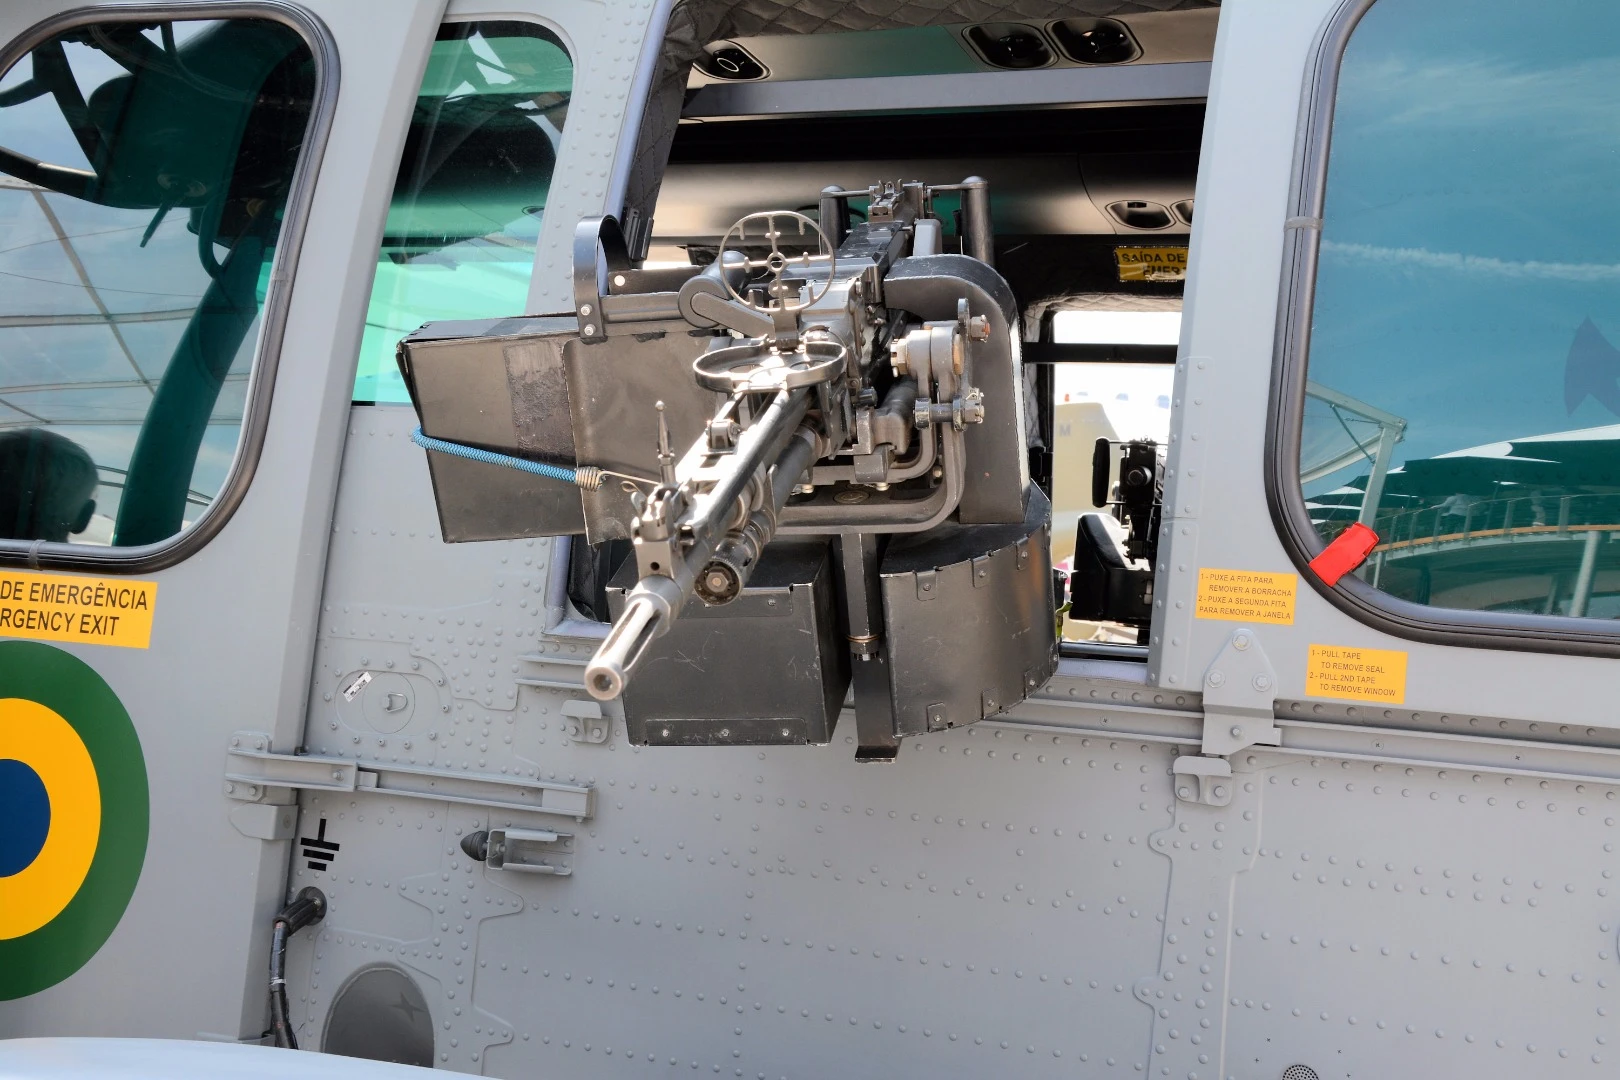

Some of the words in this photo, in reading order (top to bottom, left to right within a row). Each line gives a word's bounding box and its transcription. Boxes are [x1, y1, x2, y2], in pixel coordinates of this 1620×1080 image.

[1121, 251, 1164, 263] SAÍDA
[1166, 253, 1186, 263] DE
[1209, 573, 1229, 582] PUXE
[1237, 575, 1252, 583] FITA
[1253, 576, 1274, 585] PARA
[0, 580, 25, 601] DE
[29, 582, 148, 611] EMERGÊNCIA
[1208, 584, 1244, 594] REMOVER
[1251, 587, 1292, 597] BORRACHA
[1207, 595, 1227, 604] PUXE
[1234, 597, 1269, 607] SEGUNDA
[1270, 600, 1287, 608] FITA
[1199, 606, 1219, 614] PARA
[1219, 607, 1255, 617] REMOVER
[1255, 610, 1261, 618] A
[1262, 611, 1291, 620] JANELA
[79, 613, 120, 636] EXIT
[1321, 649, 1340, 658] PULL
[1342, 651, 1361, 660] TAPE
[1321, 661, 1331, 669] TO
[1332, 662, 1364, 672] REMOVE
[1365, 665, 1385, 674] SEAL
[1319, 672, 1338, 681] PULL
[1340, 674, 1355, 682] 2ND
[1357, 675, 1376, 684] TAPE
[1319, 683, 1329, 691] TO
[1330, 684, 1362, 694] REMOVE
[1363, 687, 1396, 696] WINDOW
